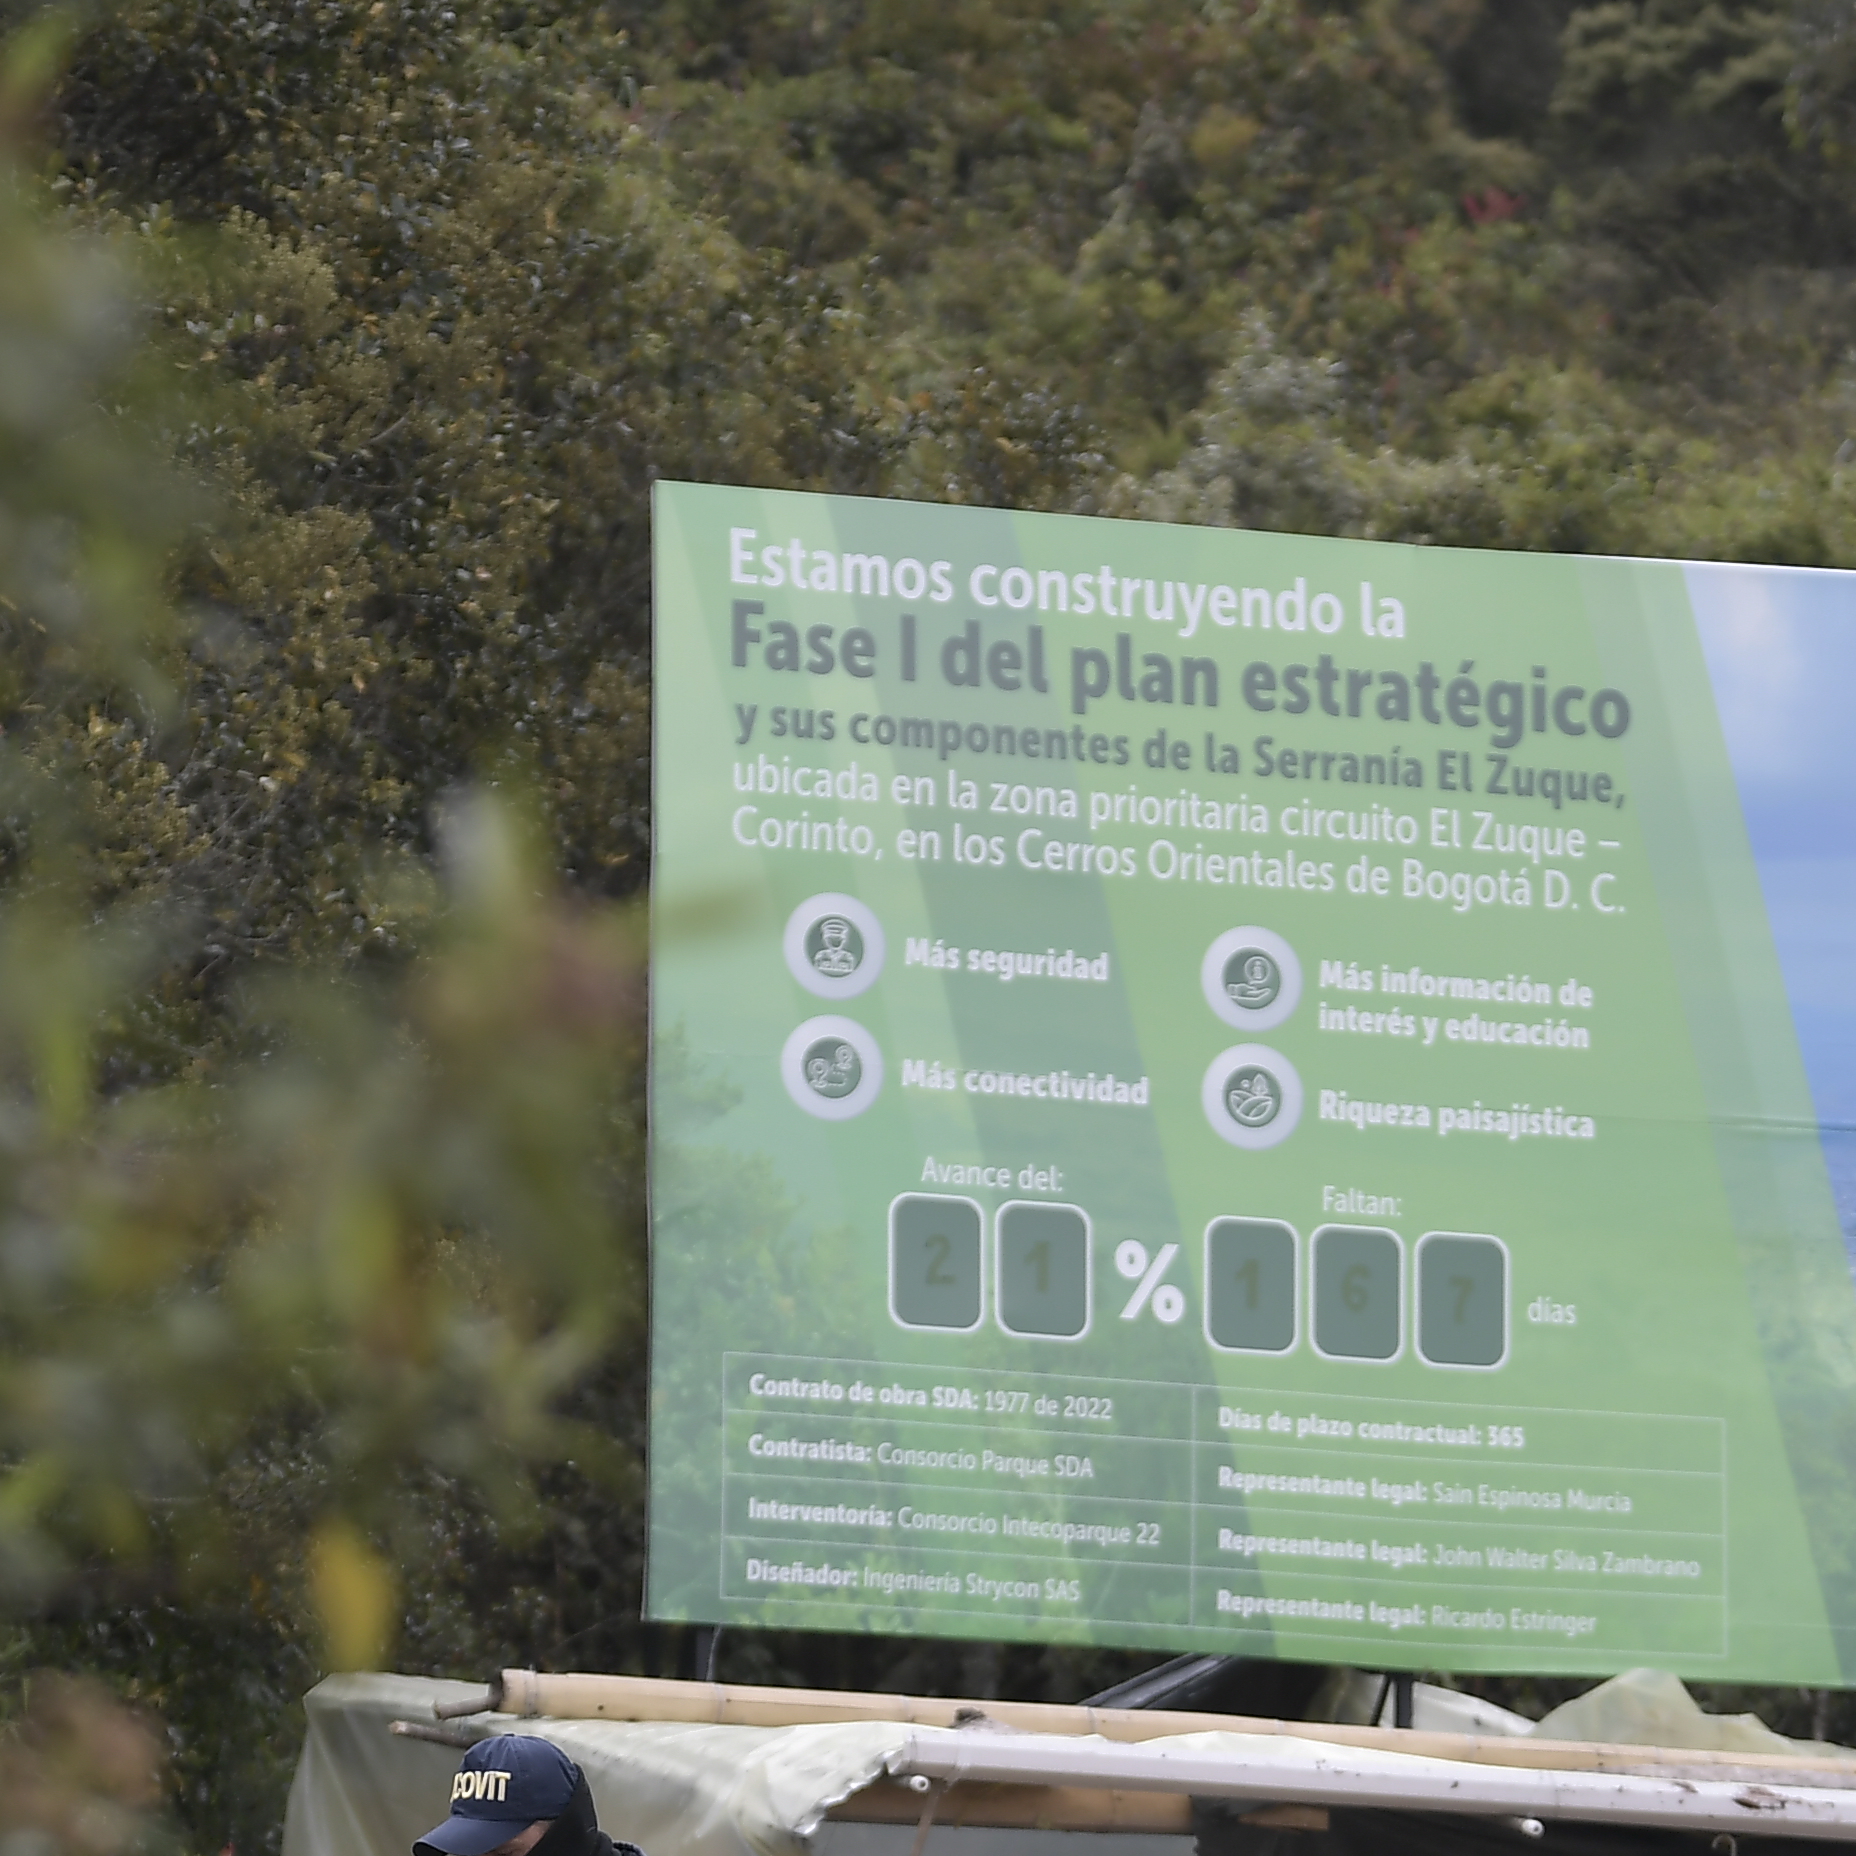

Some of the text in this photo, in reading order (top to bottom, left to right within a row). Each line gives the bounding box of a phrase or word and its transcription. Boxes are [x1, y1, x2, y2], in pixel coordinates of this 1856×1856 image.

[730, 527, 1405, 639] Estamos construyendo la
[730, 598, 1632, 751] Fase I del plan estratégico
[734, 703, 1625, 810] y sus componentes de la Serranía El Zuque,
[734, 752, 880, 801] ubicada
[890, 774, 937, 808] en
[946, 768, 981, 809] la
[988, 782, 1080, 818] zona
[1089, 783, 1272, 834] prioritaria
[1278, 797, 1423, 845] circuito
[1428, 806, 1463, 850] El
[1470, 810, 1589, 863] Zuque
[732, 805, 1627, 914] Corinto, en los Cerros Orientales de Bogotá D. C.
[905, 937, 1109, 982] Más seguridad
[1318, 959, 1594, 1009] Más información de
[1318, 1001, 1590, 1049] interés y educación
[901, 1058, 1149, 1106] Más conectividad
[1318, 1089, 1596, 1141] Riqueza paisajística
[921, 1157, 1064, 1194] Avance del:
[1322, 1185, 1402, 1218] Faltan:
[1526, 1295, 1577, 1325] días
[749, 1372, 1113, 1422] Contrato de obra SDA: 1977 de 2022
[1217, 1405, 1525, 1449] Días de plazo contractual: 365
[748, 1433, 1094, 1479] Contratista: Consorcio Parque SDA
[1217, 1465, 1367, 1499] Representante
[1370, 1477, 1428, 1507] legal:
[1477, 1484, 1562, 1511] Espinosa
[1567, 1489, 1632, 1513] Murcia
[748, 1496, 1161, 1547] Interventoría: Consorcio Intecoparque 22
[1217, 1527, 1700, 1577] Representante legal: John Walter Silva Zambrano
[746, 1558, 1081, 1602] Diseñador: Ingeniería Strycon SAS
[1216, 1588, 1365, 1622] Representante
[1368, 1600, 1426, 1630] legal:
[1431, 1605, 1505, 1629] Ricardo
